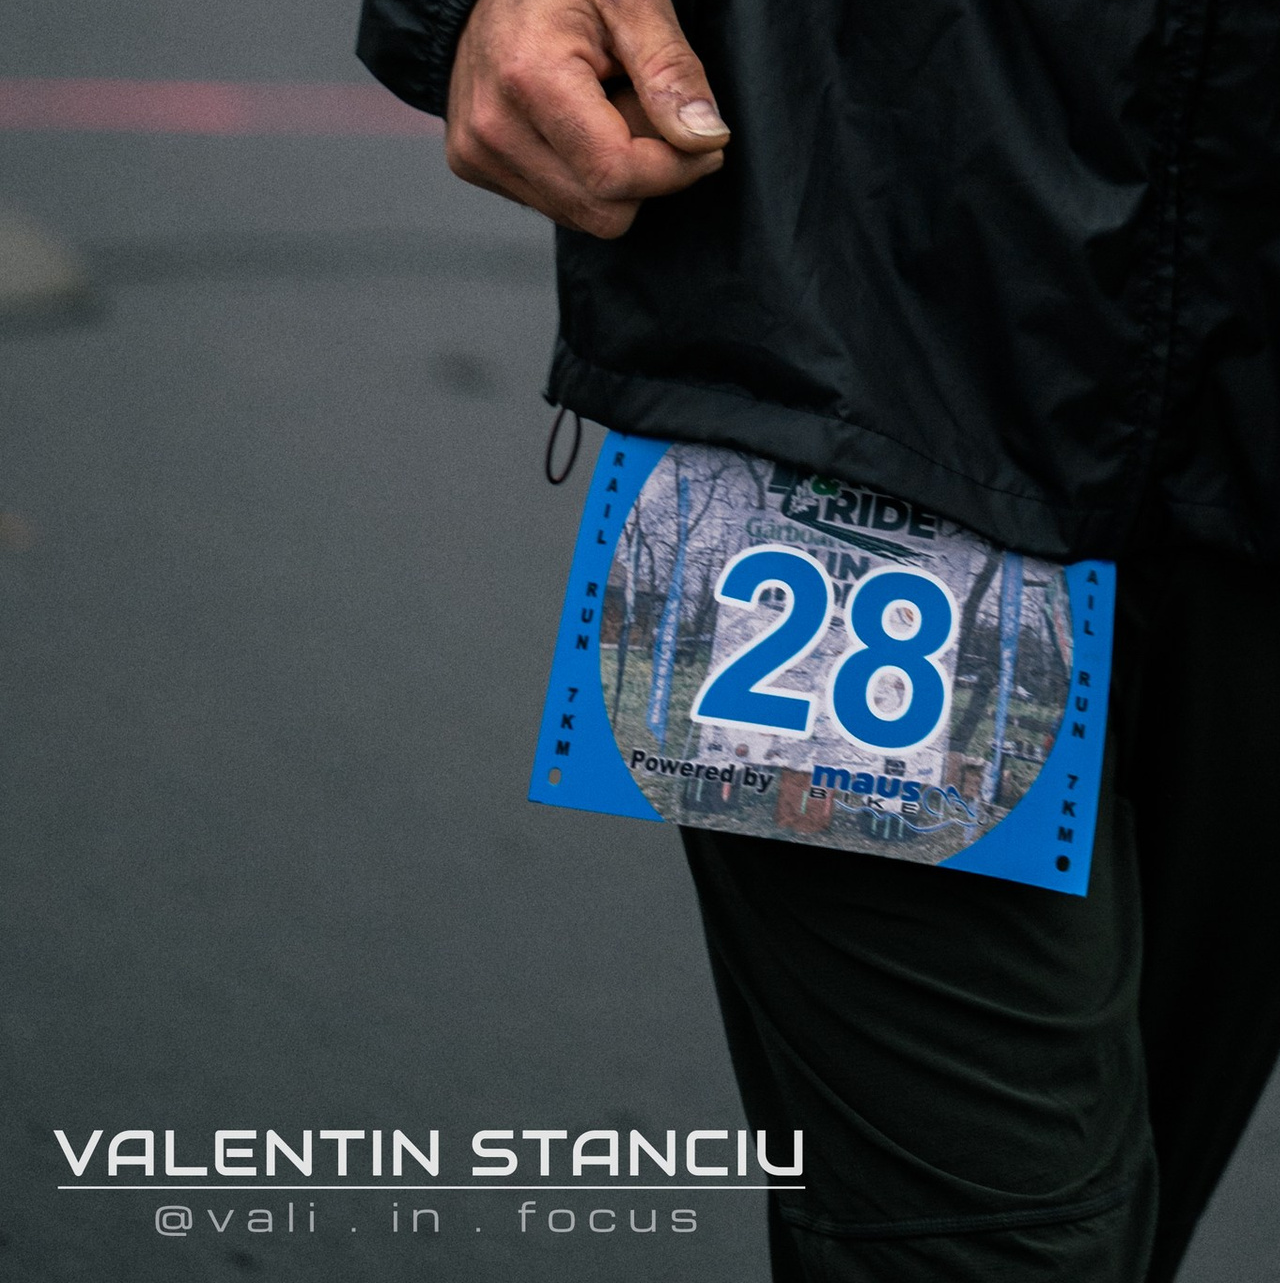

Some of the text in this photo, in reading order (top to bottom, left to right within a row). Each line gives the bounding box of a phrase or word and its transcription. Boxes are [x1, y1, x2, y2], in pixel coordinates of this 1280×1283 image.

[823, 488, 938, 541] RIDE
[554, 435, 627, 757] RAIL RUN 7KM
[694, 547, 955, 752] 28
[1071, 669, 1092, 740] RUN
[630, 749, 774, 794] Powered by
[808, 787, 921, 816] BIKE
[811, 764, 922, 803] maus
[1056, 773, 1080, 844] 7KM
